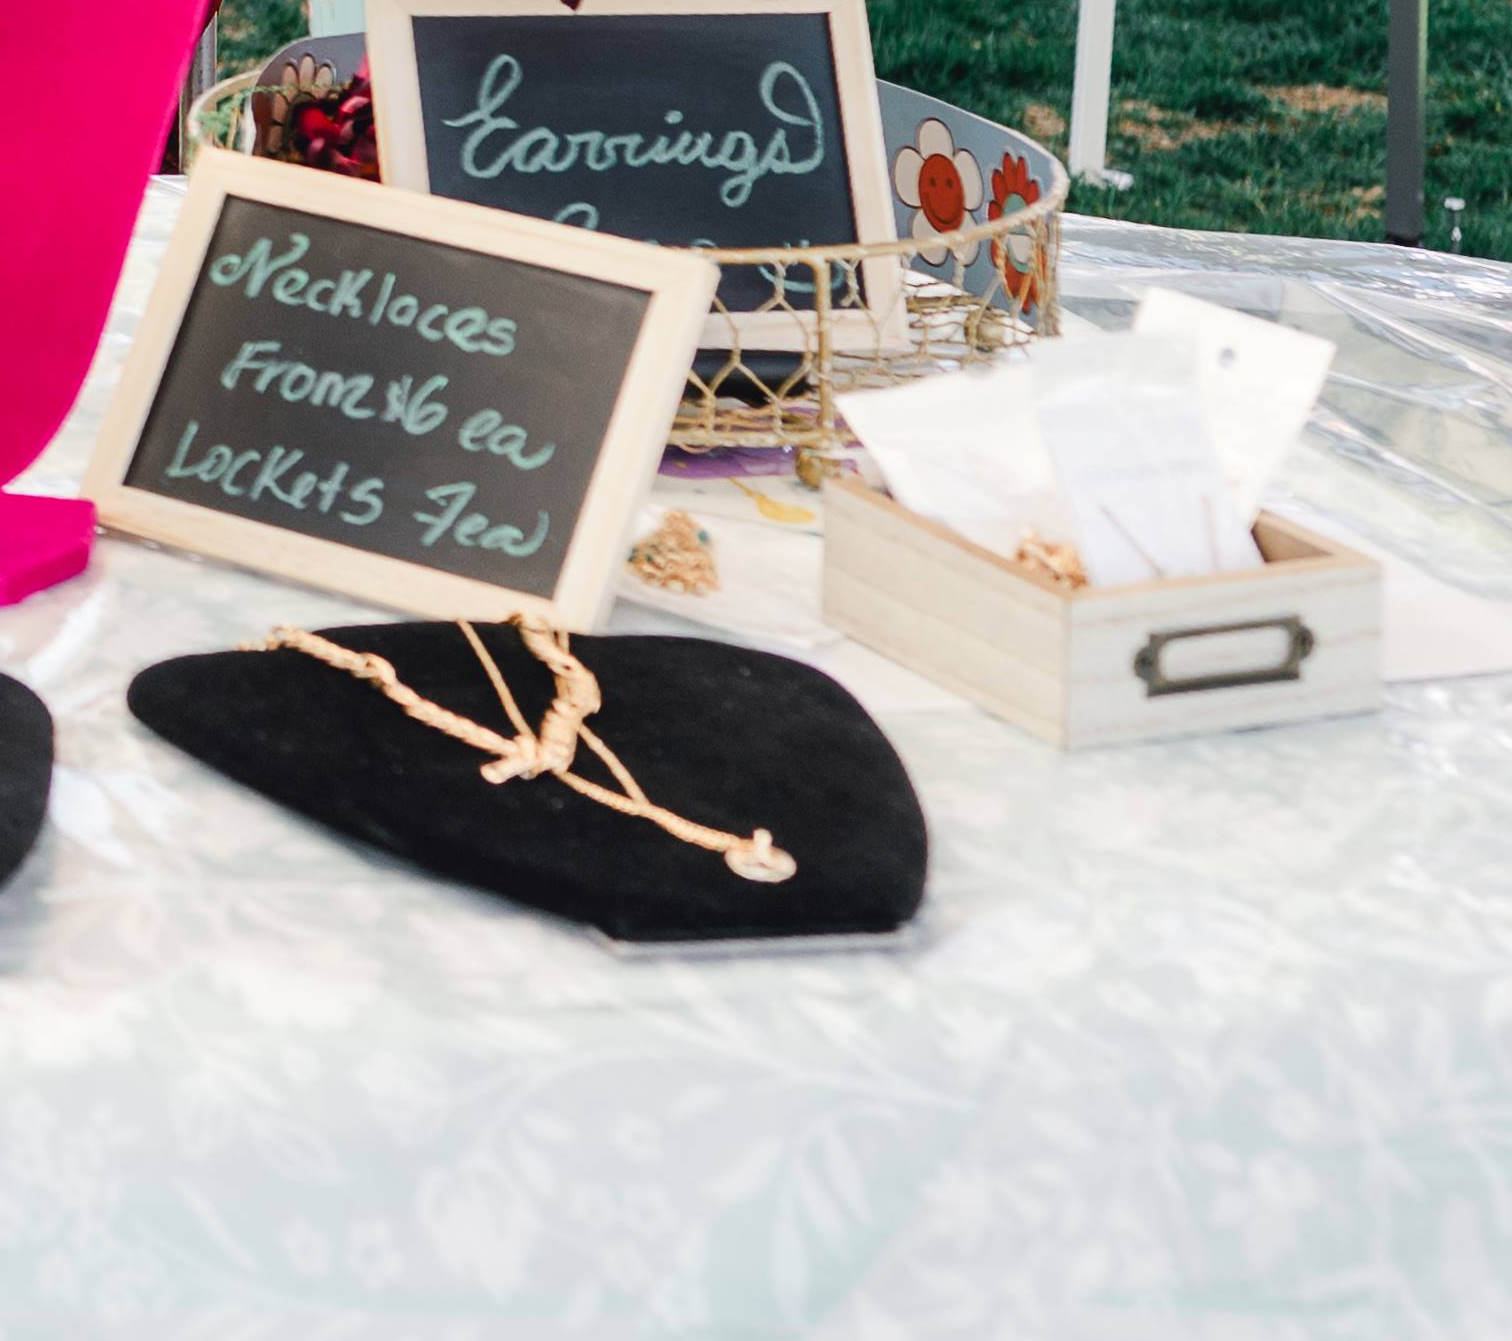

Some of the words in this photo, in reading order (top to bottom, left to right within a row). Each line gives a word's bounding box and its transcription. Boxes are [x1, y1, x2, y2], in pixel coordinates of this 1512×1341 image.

[440, 52, 826, 209] Earrings
[207, 232, 519, 358] Necklaces
[219, 340, 377, 421] From
